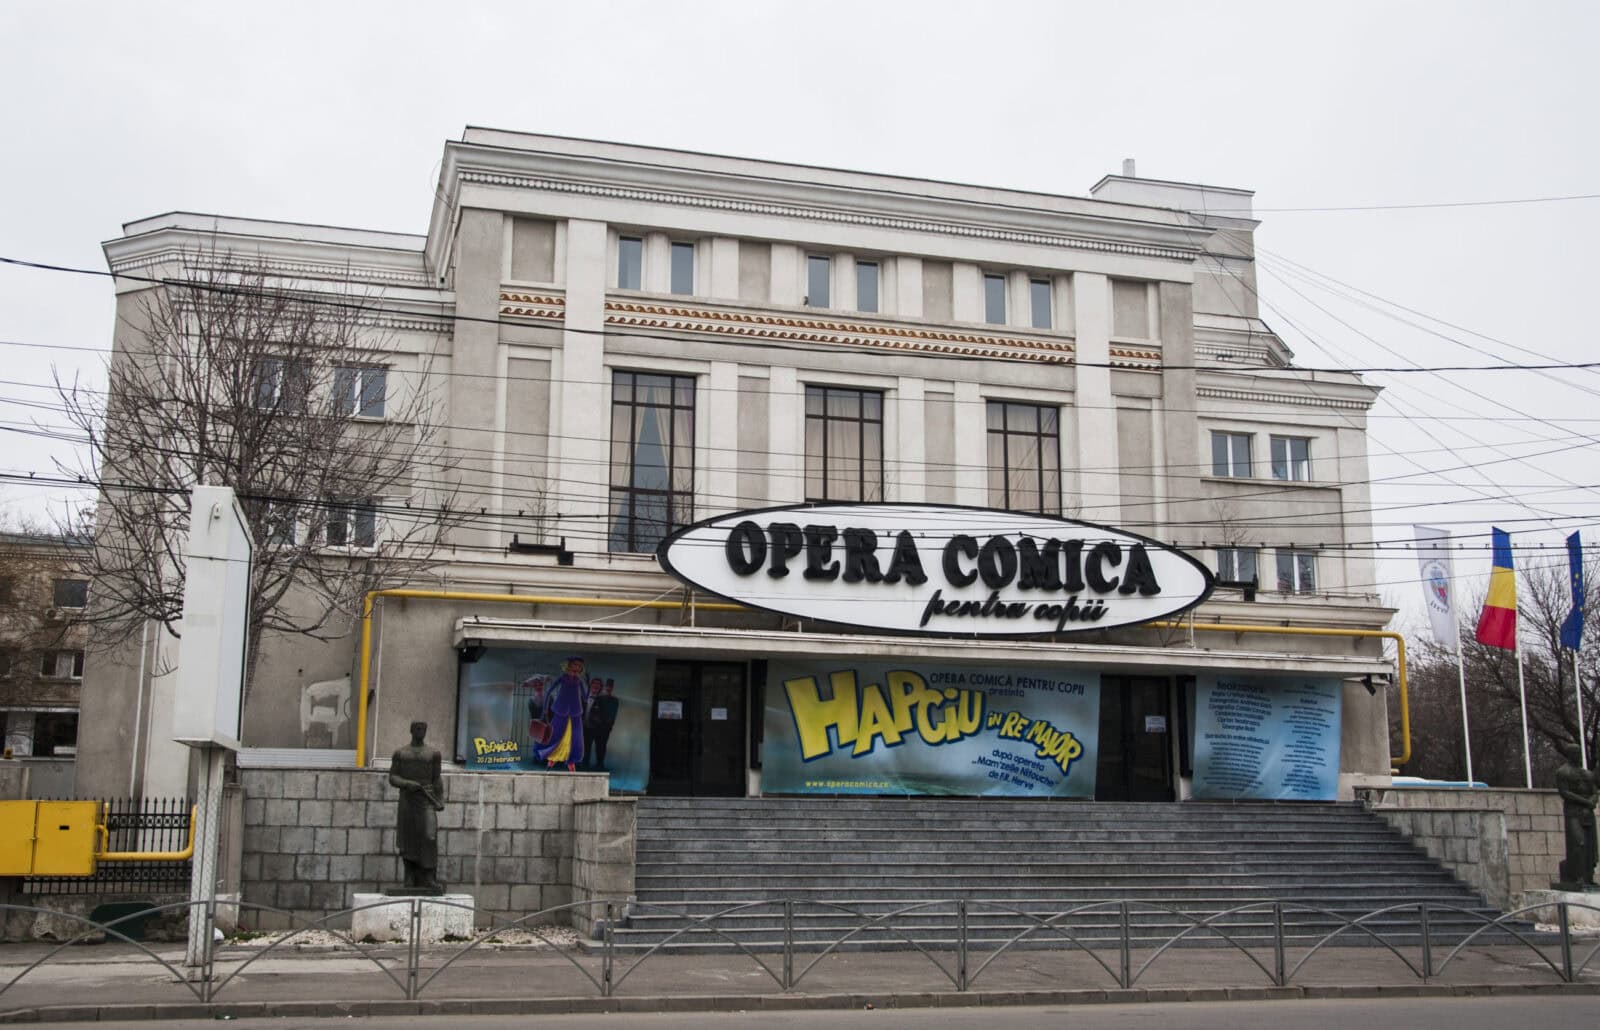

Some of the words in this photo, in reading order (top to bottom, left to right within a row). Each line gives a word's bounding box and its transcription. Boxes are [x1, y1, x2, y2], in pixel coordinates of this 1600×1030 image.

[725, 520, 928, 585] OPERA
[942, 533, 1161, 596] COMICA
[920, 589, 1032, 627] pentru
[1033, 595, 1110, 632] copii
[930, 673, 966, 685] OPERA
[1017, 677, 1056, 693] PENTRU
[1058, 682, 1085, 696] COPII
[999, 711, 1030, 740] RE
[1025, 720, 1083, 777] MAJOR
[988, 770, 999, 779] de
[1013, 755, 1045, 772] opereta
